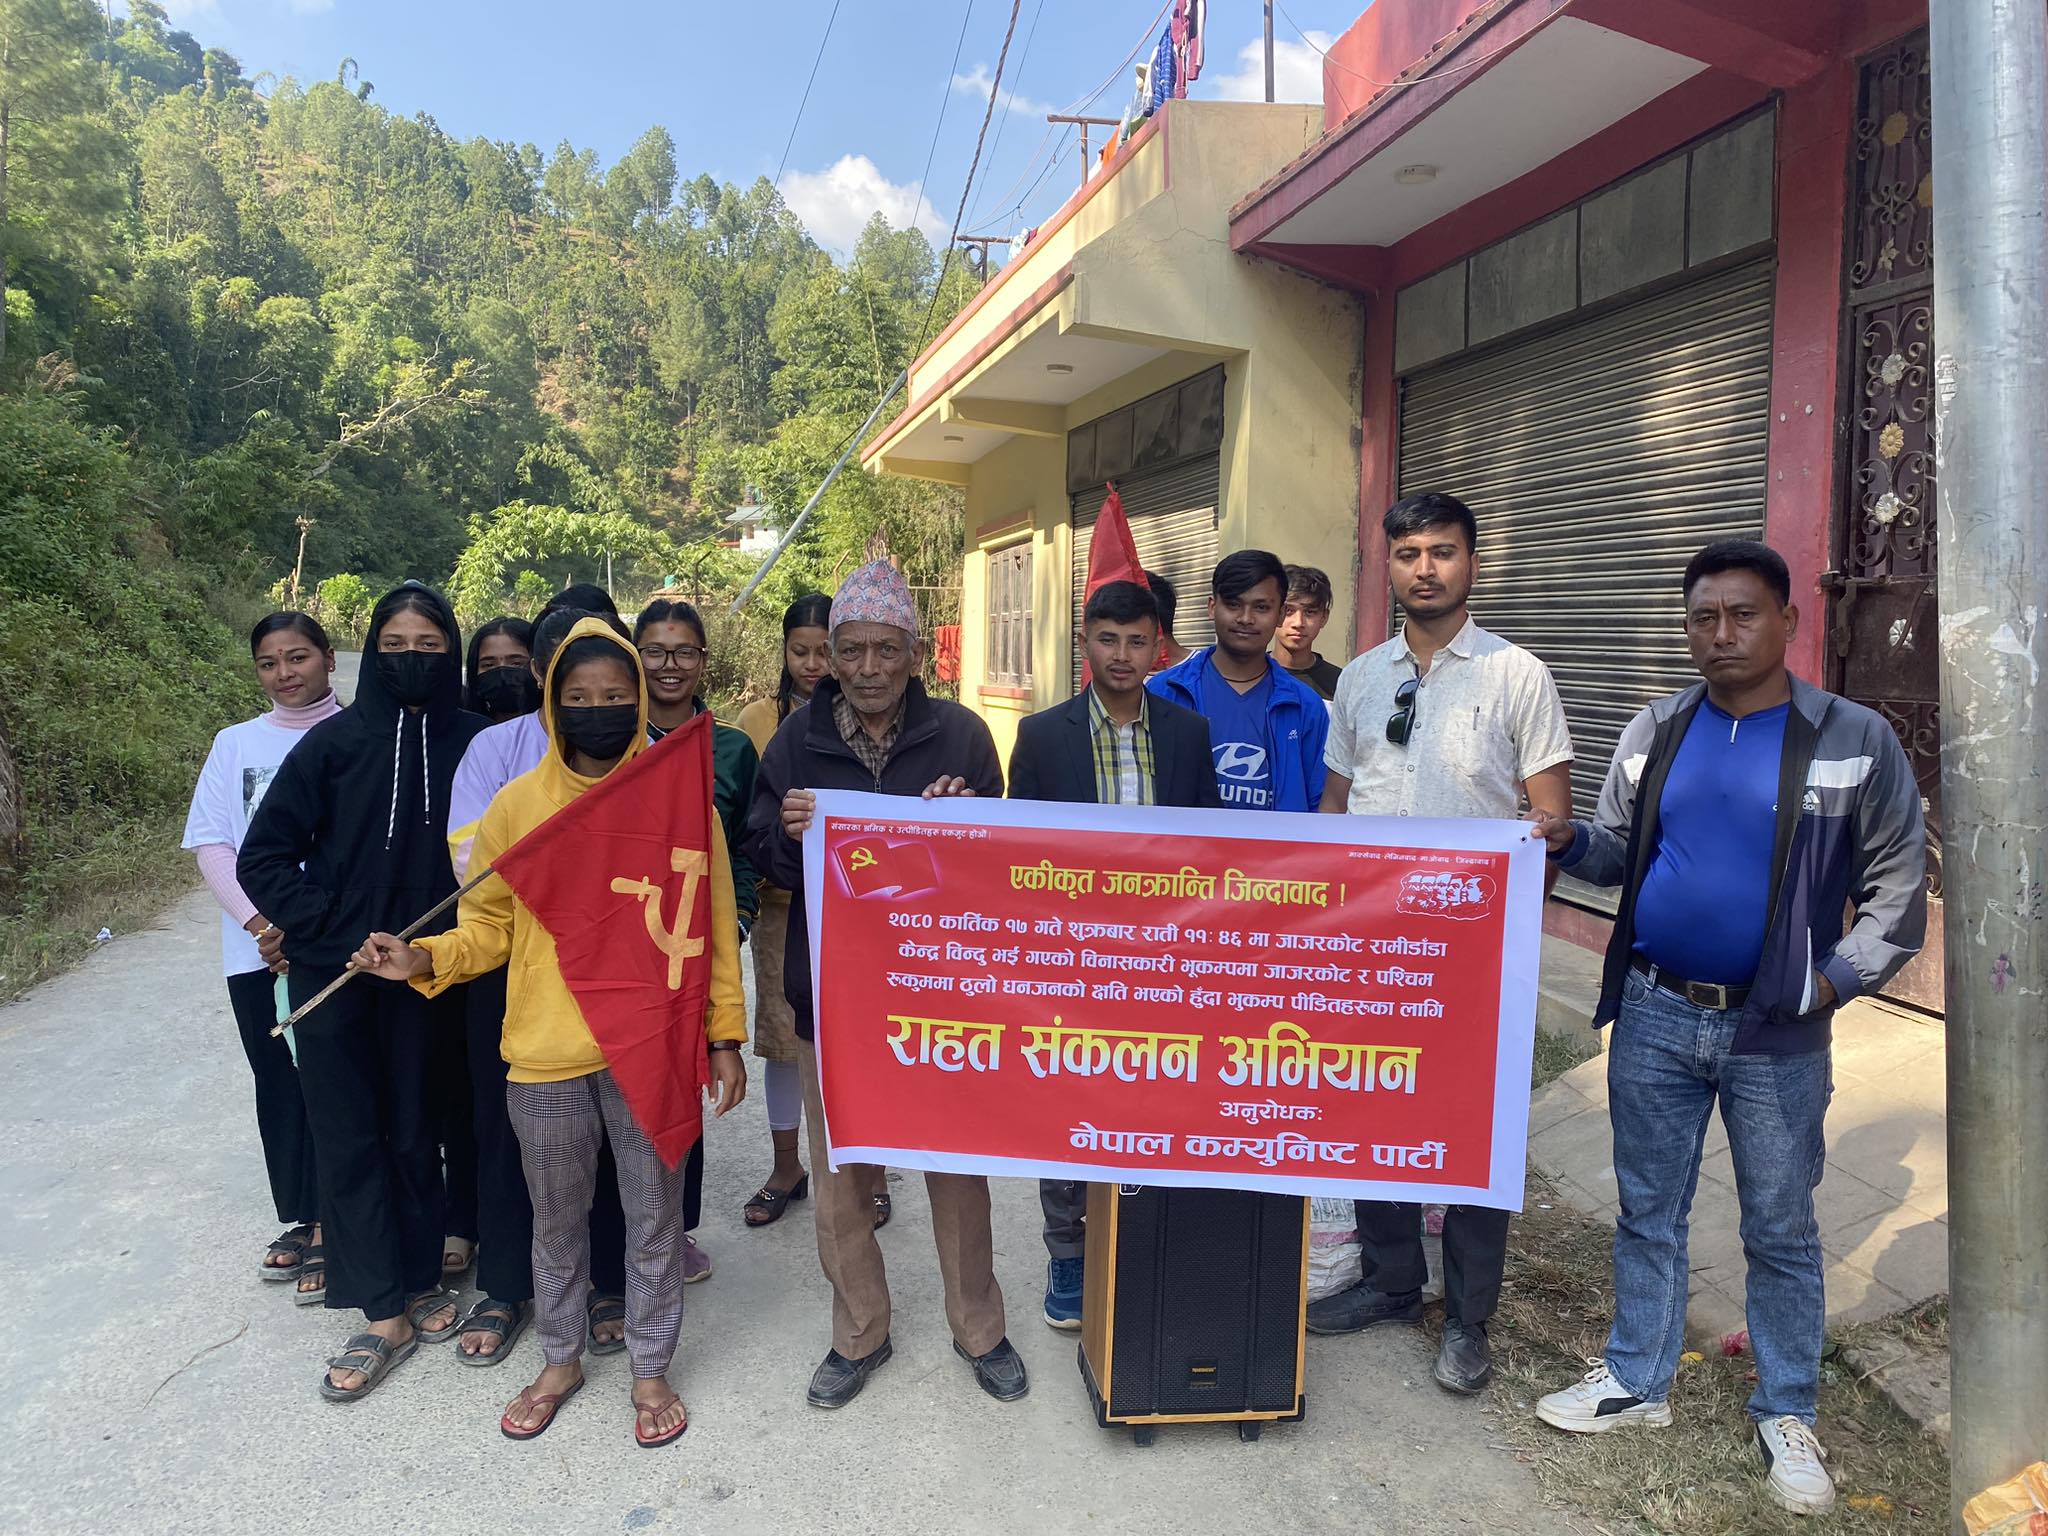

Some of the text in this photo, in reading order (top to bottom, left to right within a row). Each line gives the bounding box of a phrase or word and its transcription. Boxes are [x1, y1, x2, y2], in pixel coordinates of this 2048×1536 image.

[1010, 860, 1346, 908] एकीकृत जनक्रान्ति जिन्दावाद !
[888, 912, 933, 929] २०८०
[938, 911, 1001, 932] कार्तिक
[1004, 918, 1028, 934] १७
[1034, 916, 1063, 936] गते
[1067, 922, 1138, 942] शुक्रबार
[1141, 923, 1180, 943] राती
[1247, 931, 1271, 948] मा
[1275, 932, 1365, 953] जाजरकोट
[1370, 936, 1449, 957] रामीडाँडा
[898, 940, 1435, 987] केन्द्र विन्दु भई गएको विनासकारी भूकम्पमा जाजरकोट र पश्चिम
[960, 974, 998, 996] ठुलो
[1003, 979, 1087, 998] धनजनको
[1091, 980, 1129, 1001] क्षति
[1133, 985, 1185, 1004] भएको
[1189, 986, 1222, 1009] हुँदा
[1227, 992, 1286, 1012] भुकम्प
[1399, 998, 1445, 1019] लागि
[886, 1014, 1423, 1095] राहत संकलन अभियान
[1069, 1121, 1449, 1170] नेपाल कम्युनिष्ट पार्टी
